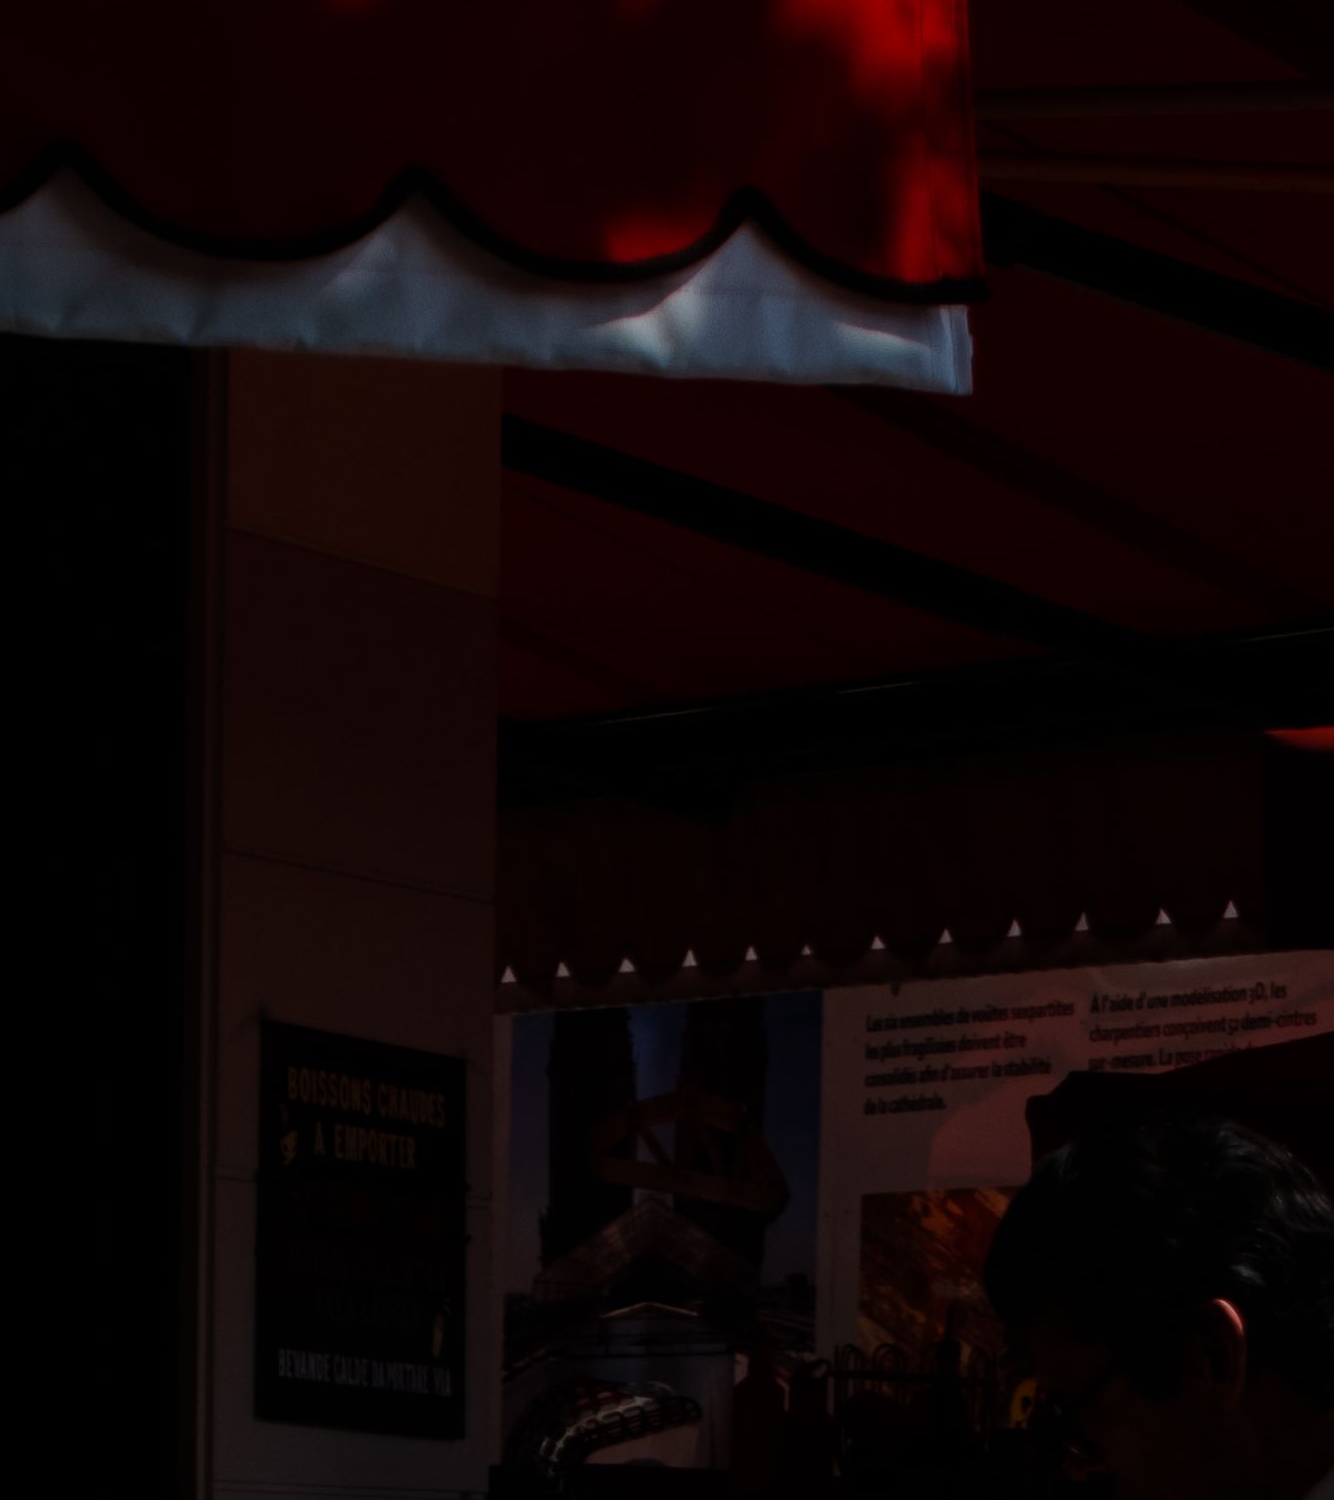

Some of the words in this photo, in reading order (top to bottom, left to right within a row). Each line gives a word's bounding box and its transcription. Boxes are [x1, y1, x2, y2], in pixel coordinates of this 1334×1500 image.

[286, 1064, 372, 1118] BOISSONS
[377, 1082, 447, 1131] CHAUDES
[313, 1120, 325, 1157] A
[333, 1122, 419, 1172] EMPORTER
